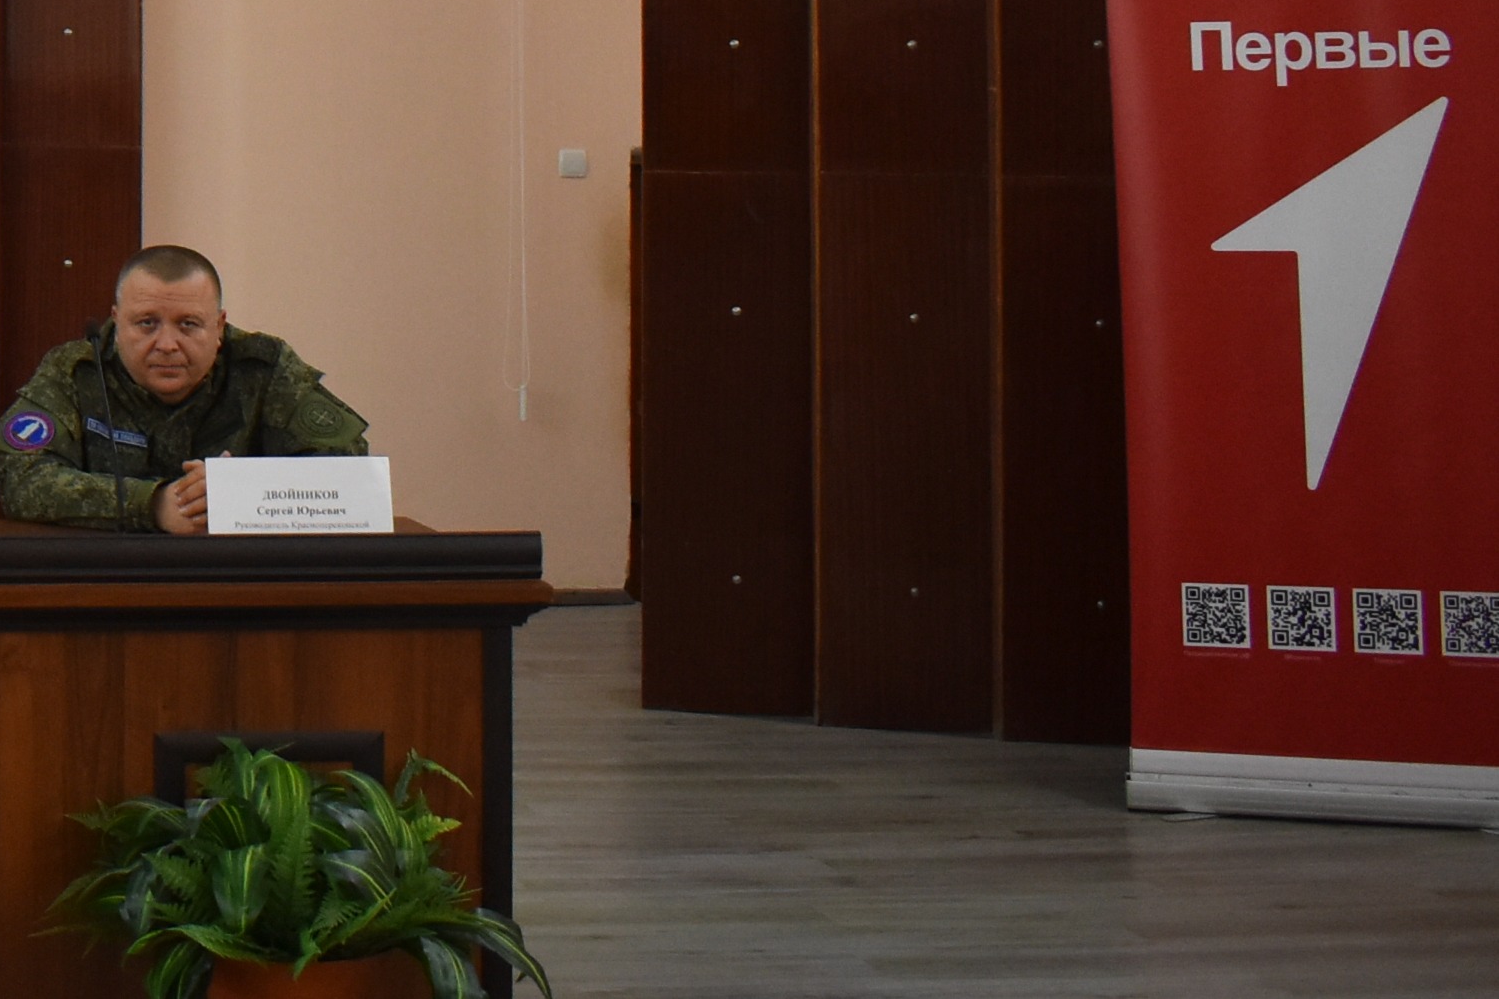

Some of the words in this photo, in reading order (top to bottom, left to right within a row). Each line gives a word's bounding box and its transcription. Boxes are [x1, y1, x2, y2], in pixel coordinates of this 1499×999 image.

[1189, 20, 1451, 87] Первые
[262, 489, 339, 501] ДВОЙНИКОВ
[257, 506, 293, 517] Сергей
[297, 505, 346, 517] Юрьевич
